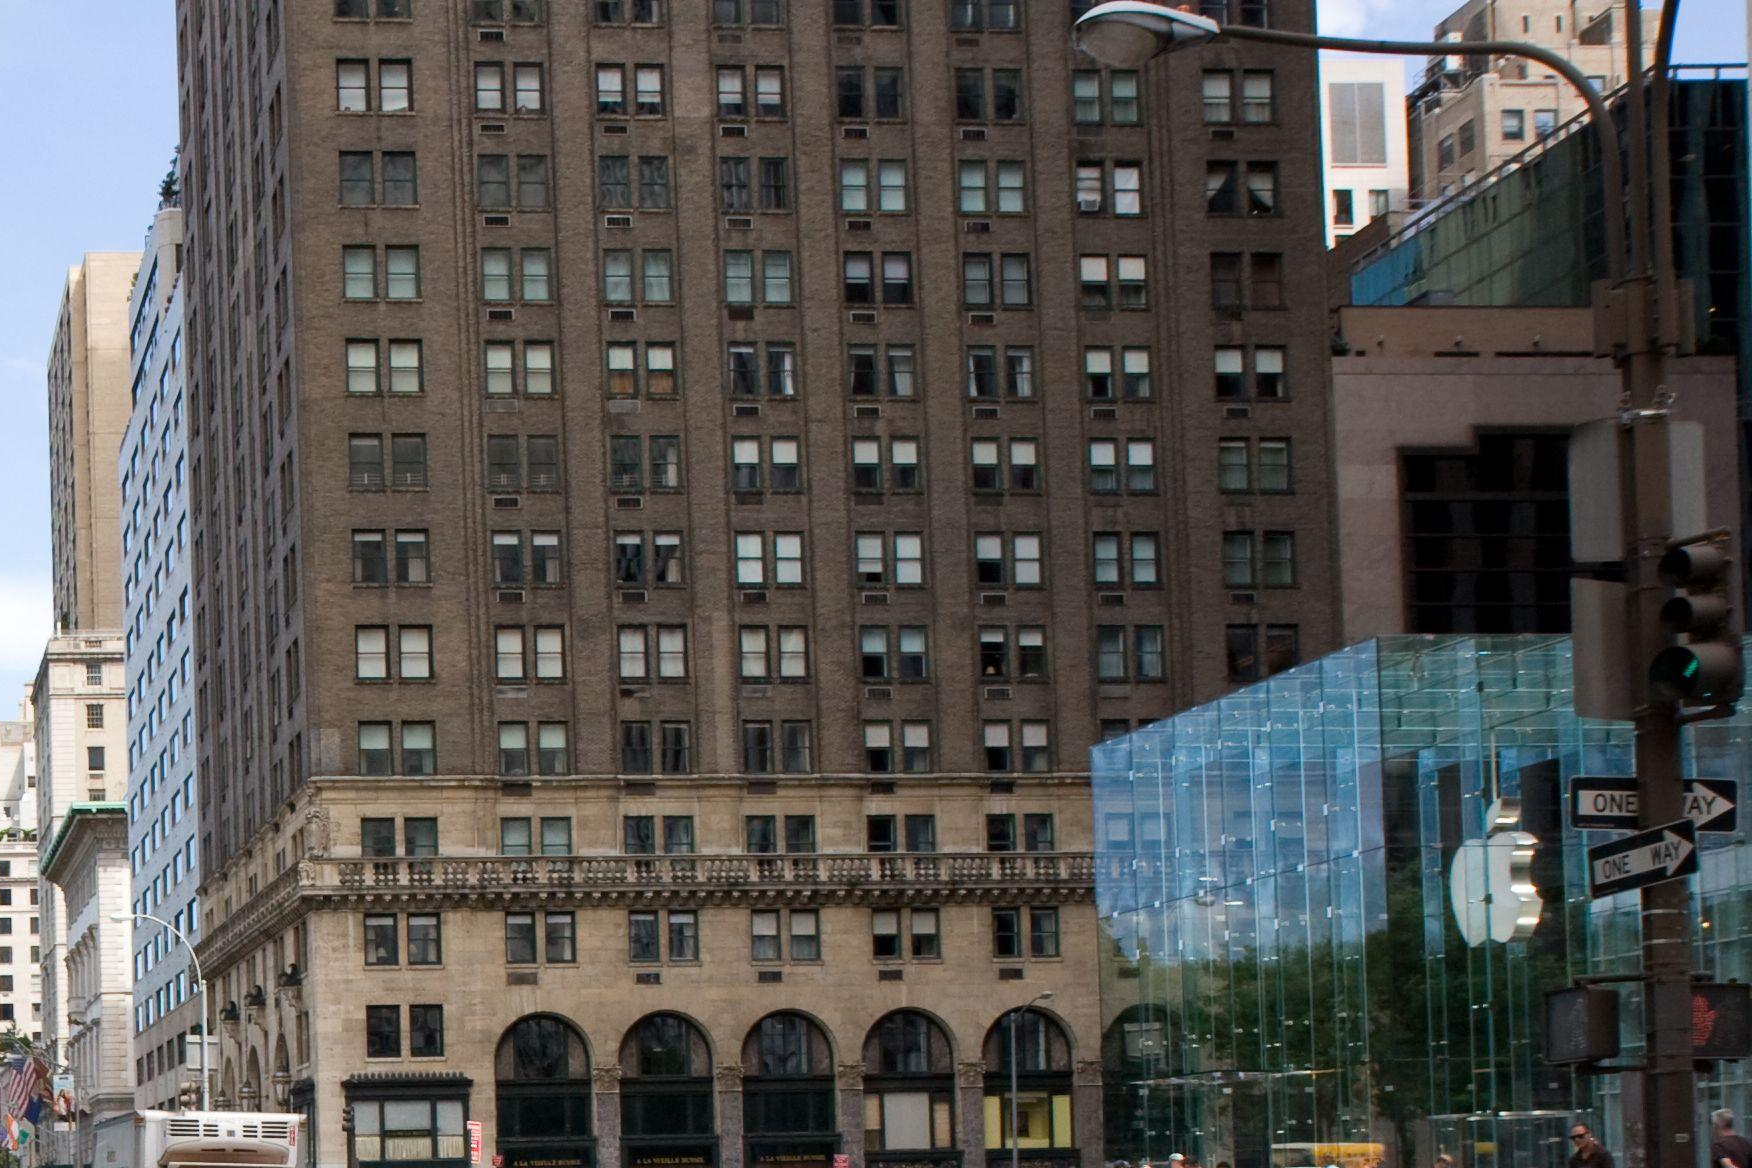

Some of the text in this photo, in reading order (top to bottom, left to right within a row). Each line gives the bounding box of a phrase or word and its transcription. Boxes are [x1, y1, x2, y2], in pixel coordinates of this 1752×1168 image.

[1593, 793, 1718, 815] ONE AY
[1602, 840, 1682, 879] ONE WAY
